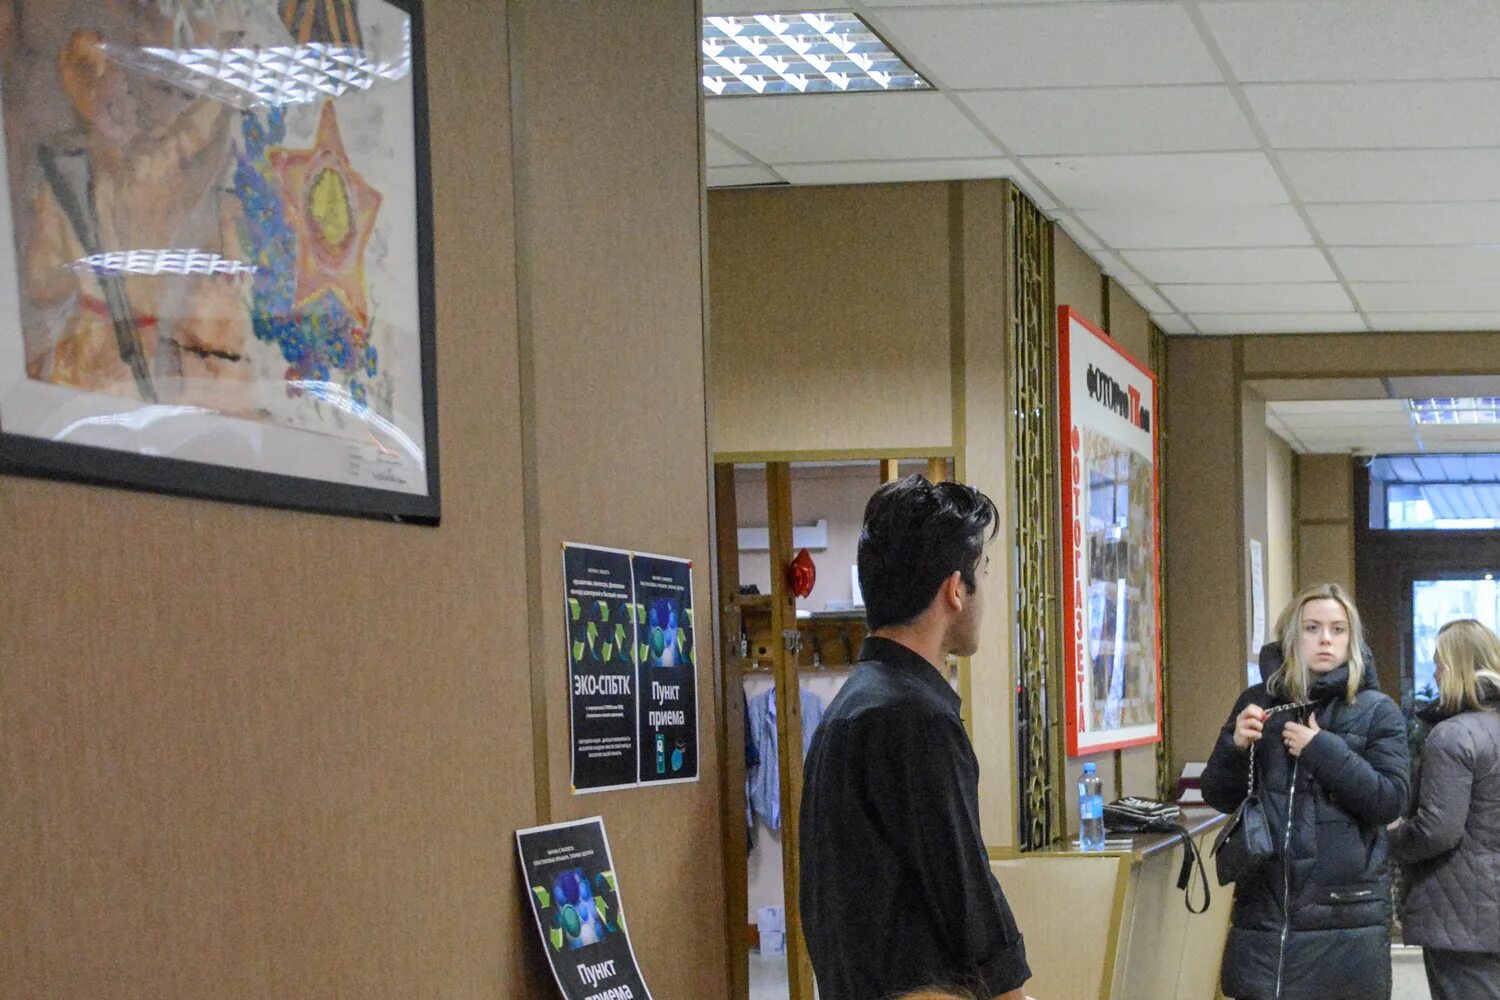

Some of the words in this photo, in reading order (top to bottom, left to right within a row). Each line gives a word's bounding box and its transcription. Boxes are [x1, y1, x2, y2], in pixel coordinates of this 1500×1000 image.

[1071, 425, 1086, 733] ФОТОГАЗЕТА
[651, 681, 680, 706] Пункт
[648, 710, 685, 732] приема
[576, 959, 617, 988] Пункт
